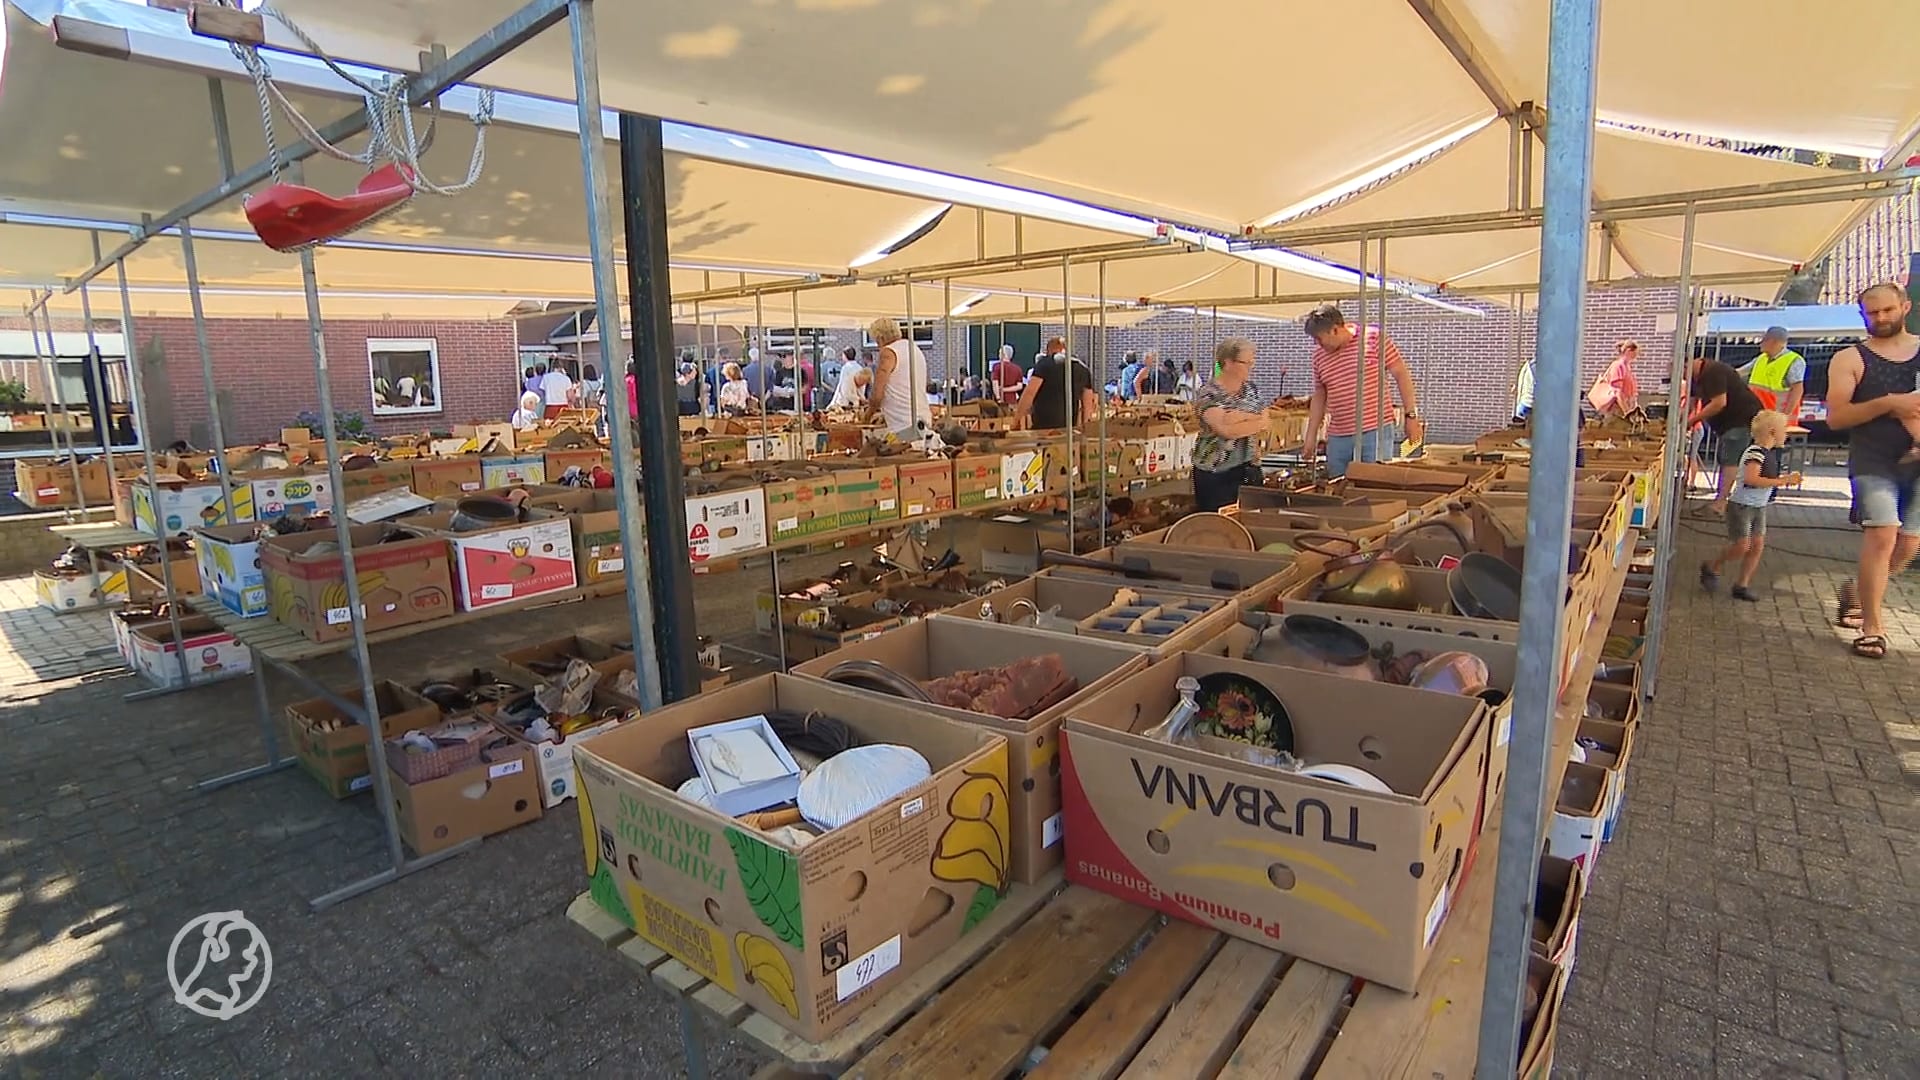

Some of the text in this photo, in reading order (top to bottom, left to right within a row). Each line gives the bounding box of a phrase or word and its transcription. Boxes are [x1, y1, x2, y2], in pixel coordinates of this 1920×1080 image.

[617, 791, 712, 857] BANANAS
[1130, 757, 1377, 852] TURBANA
[616, 816, 728, 893] FAIRTRADE
[1078, 860, 1281, 941] Premium Bananas
[855, 953, 876, 985] 477
